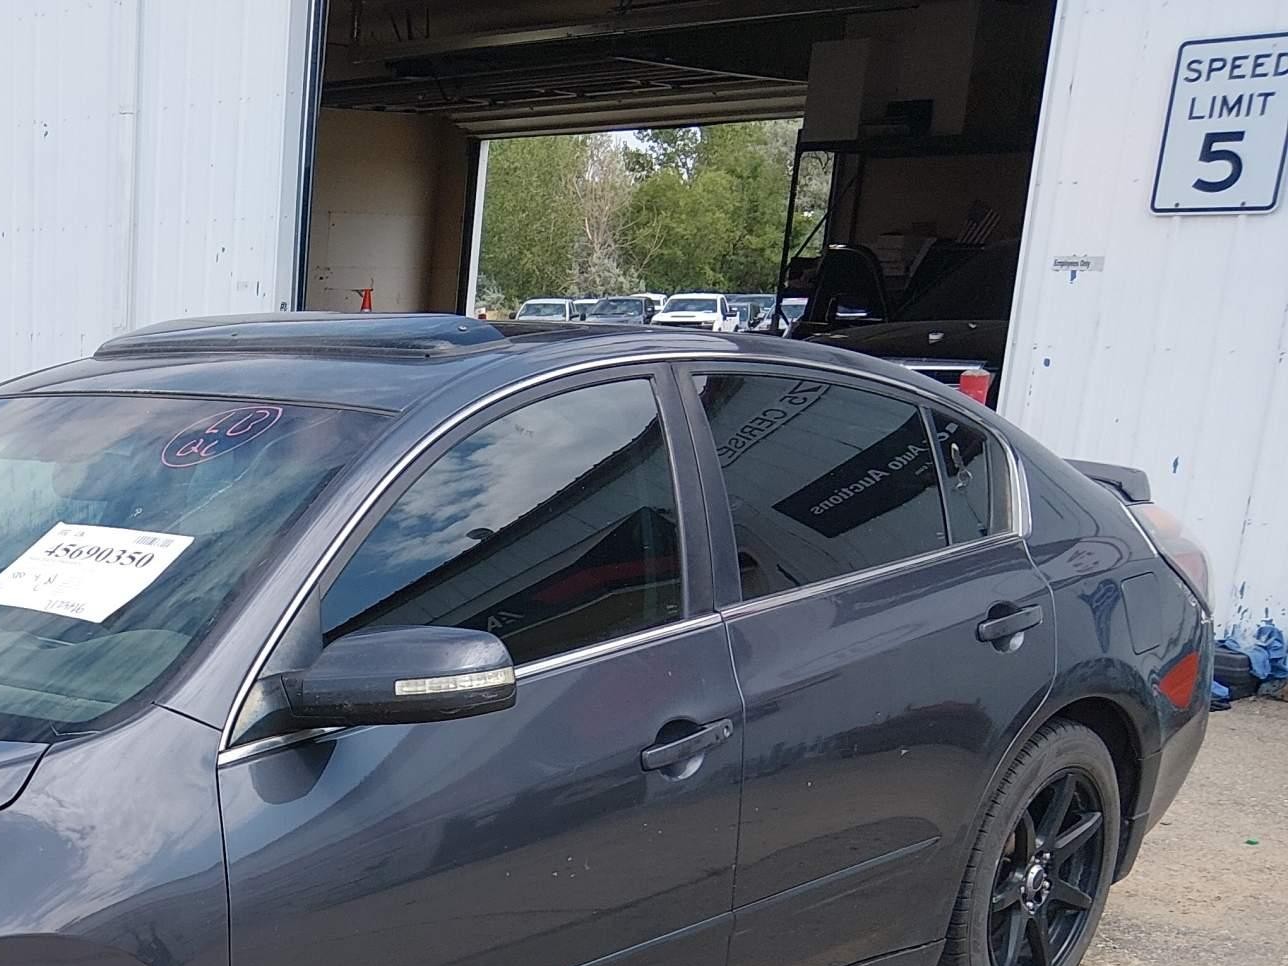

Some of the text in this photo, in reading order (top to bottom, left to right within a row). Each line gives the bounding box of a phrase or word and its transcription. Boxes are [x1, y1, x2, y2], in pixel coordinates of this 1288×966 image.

[1187, 91, 1276, 120] LIMIT
[1191, 130, 1246, 193] 5
[43, 541, 155, 569] 45690350
